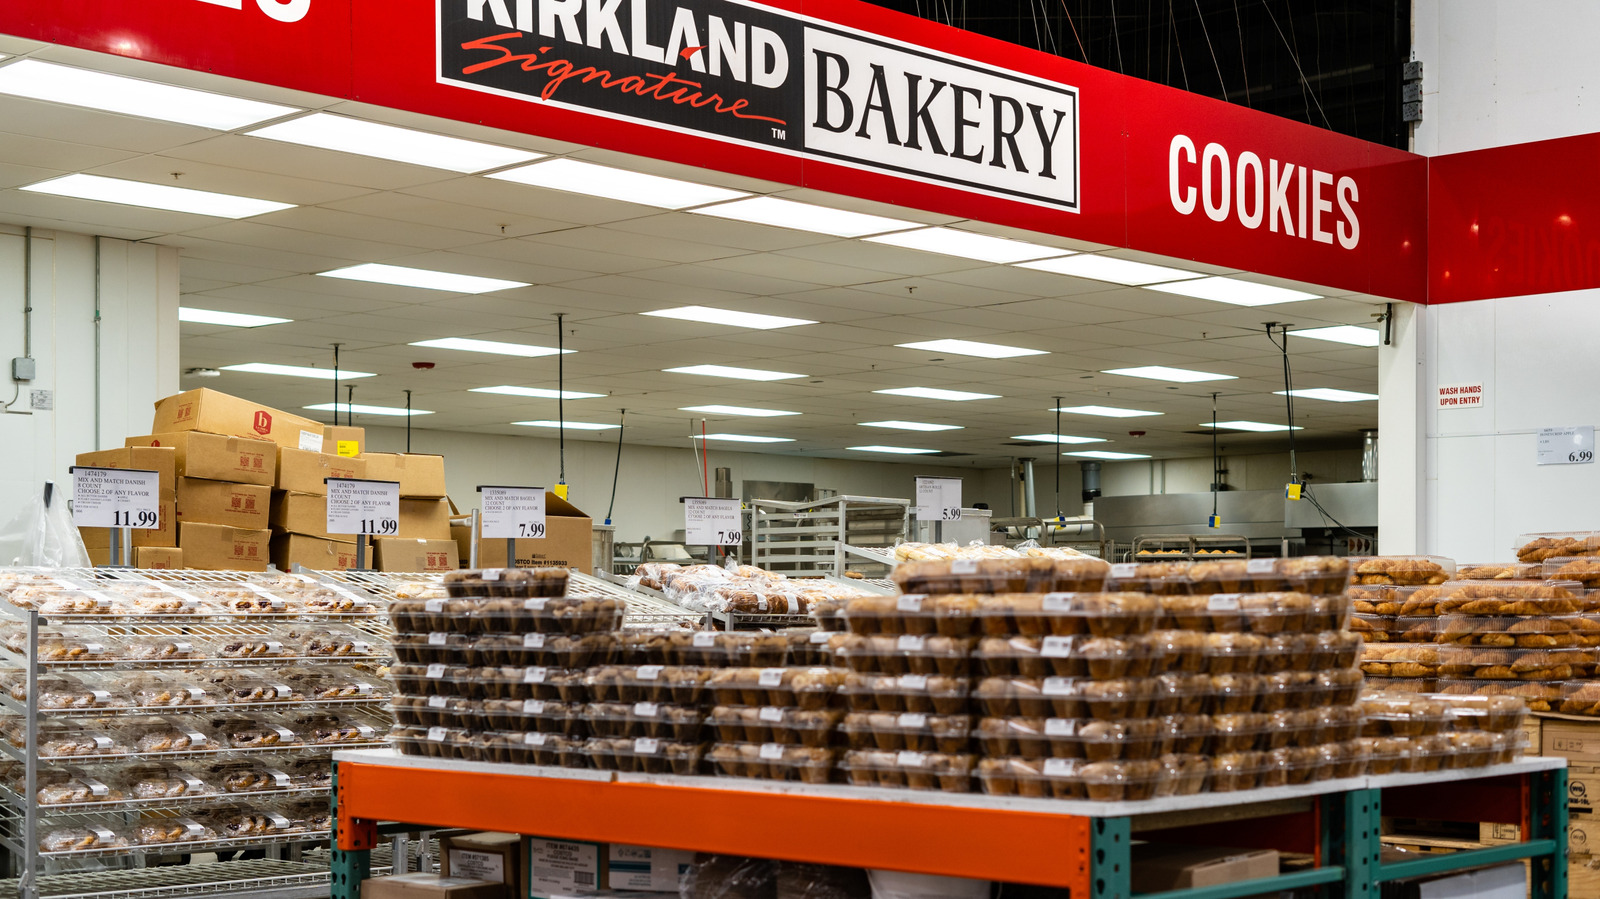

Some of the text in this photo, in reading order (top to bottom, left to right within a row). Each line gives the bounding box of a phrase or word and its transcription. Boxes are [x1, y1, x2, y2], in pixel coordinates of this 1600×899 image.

[461, 31, 786, 126] Signature
[812, 47, 1067, 181] BAKERY
[1169, 134, 1360, 250] COOKIES
[1439, 386, 1481, 395] WASH HANDS
[1459, 396, 1480, 404] ENTRY
[1568, 451, 1592, 462] 6.99
[114, 510, 157, 527] 11.99
[943, 508, 960, 520] 5.99
[361, 519, 397, 534] 11.99
[519, 523, 545, 537] 7.99
[718, 531, 741, 544] 7.99
